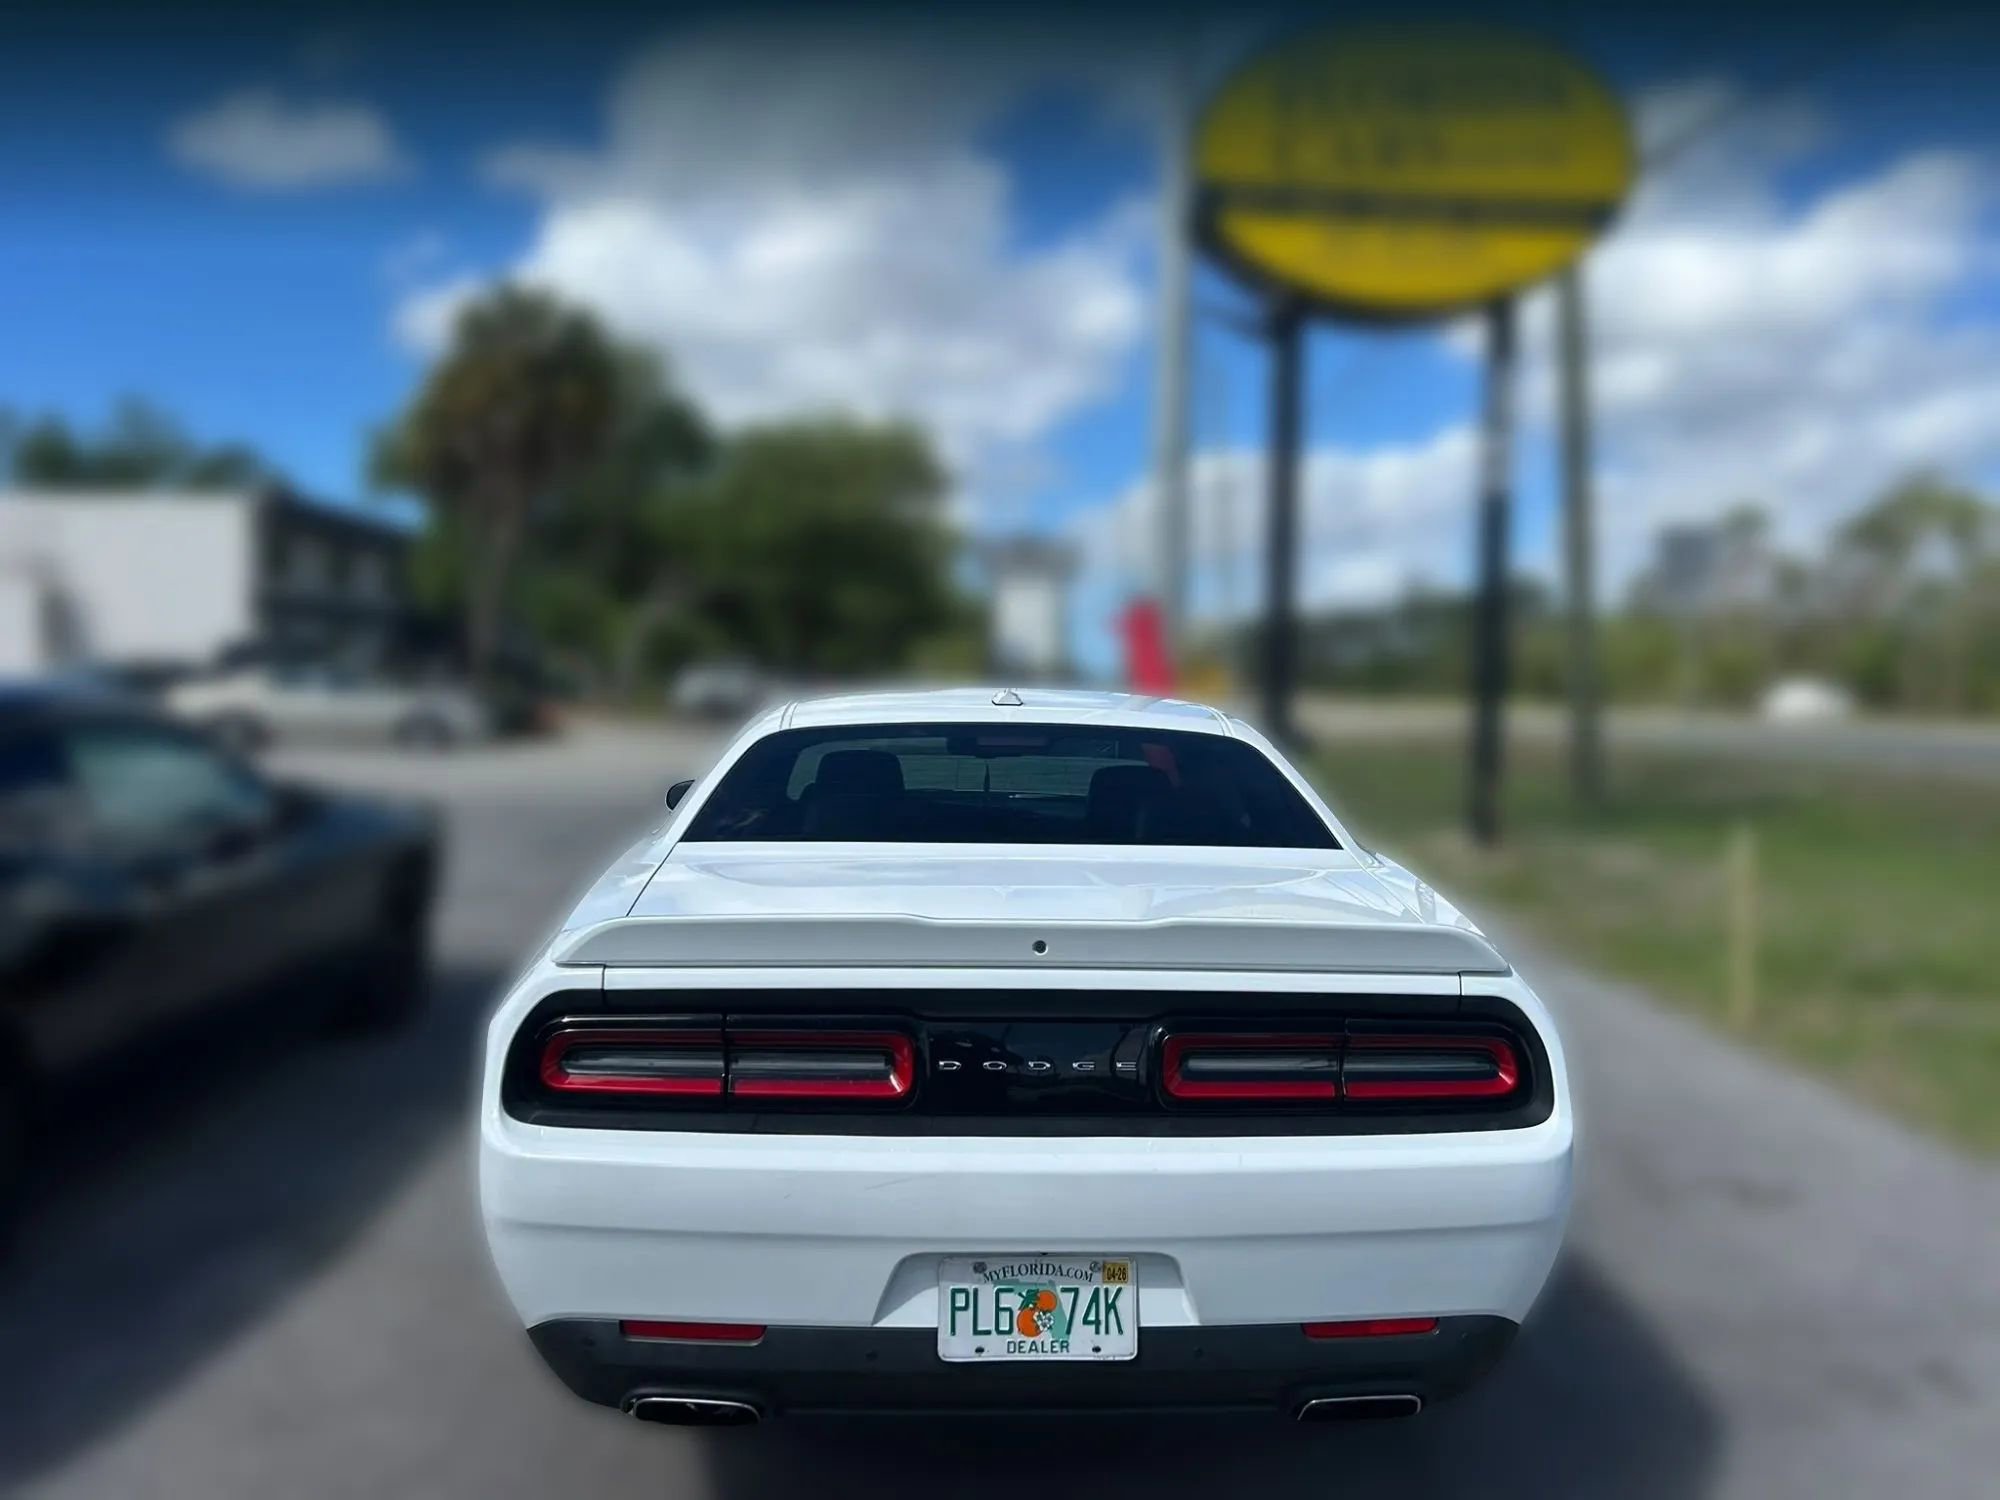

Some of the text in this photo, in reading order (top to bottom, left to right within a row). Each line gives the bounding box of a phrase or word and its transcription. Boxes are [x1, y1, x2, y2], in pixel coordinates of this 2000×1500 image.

[938, 1060, 1137, 1071] DODGE
[983, 1263, 1093, 1282] MYFLORIDA.COM
[950, 1287, 1124, 1336] PL6 74K
[1007, 1340, 1070, 1354] DEALER
